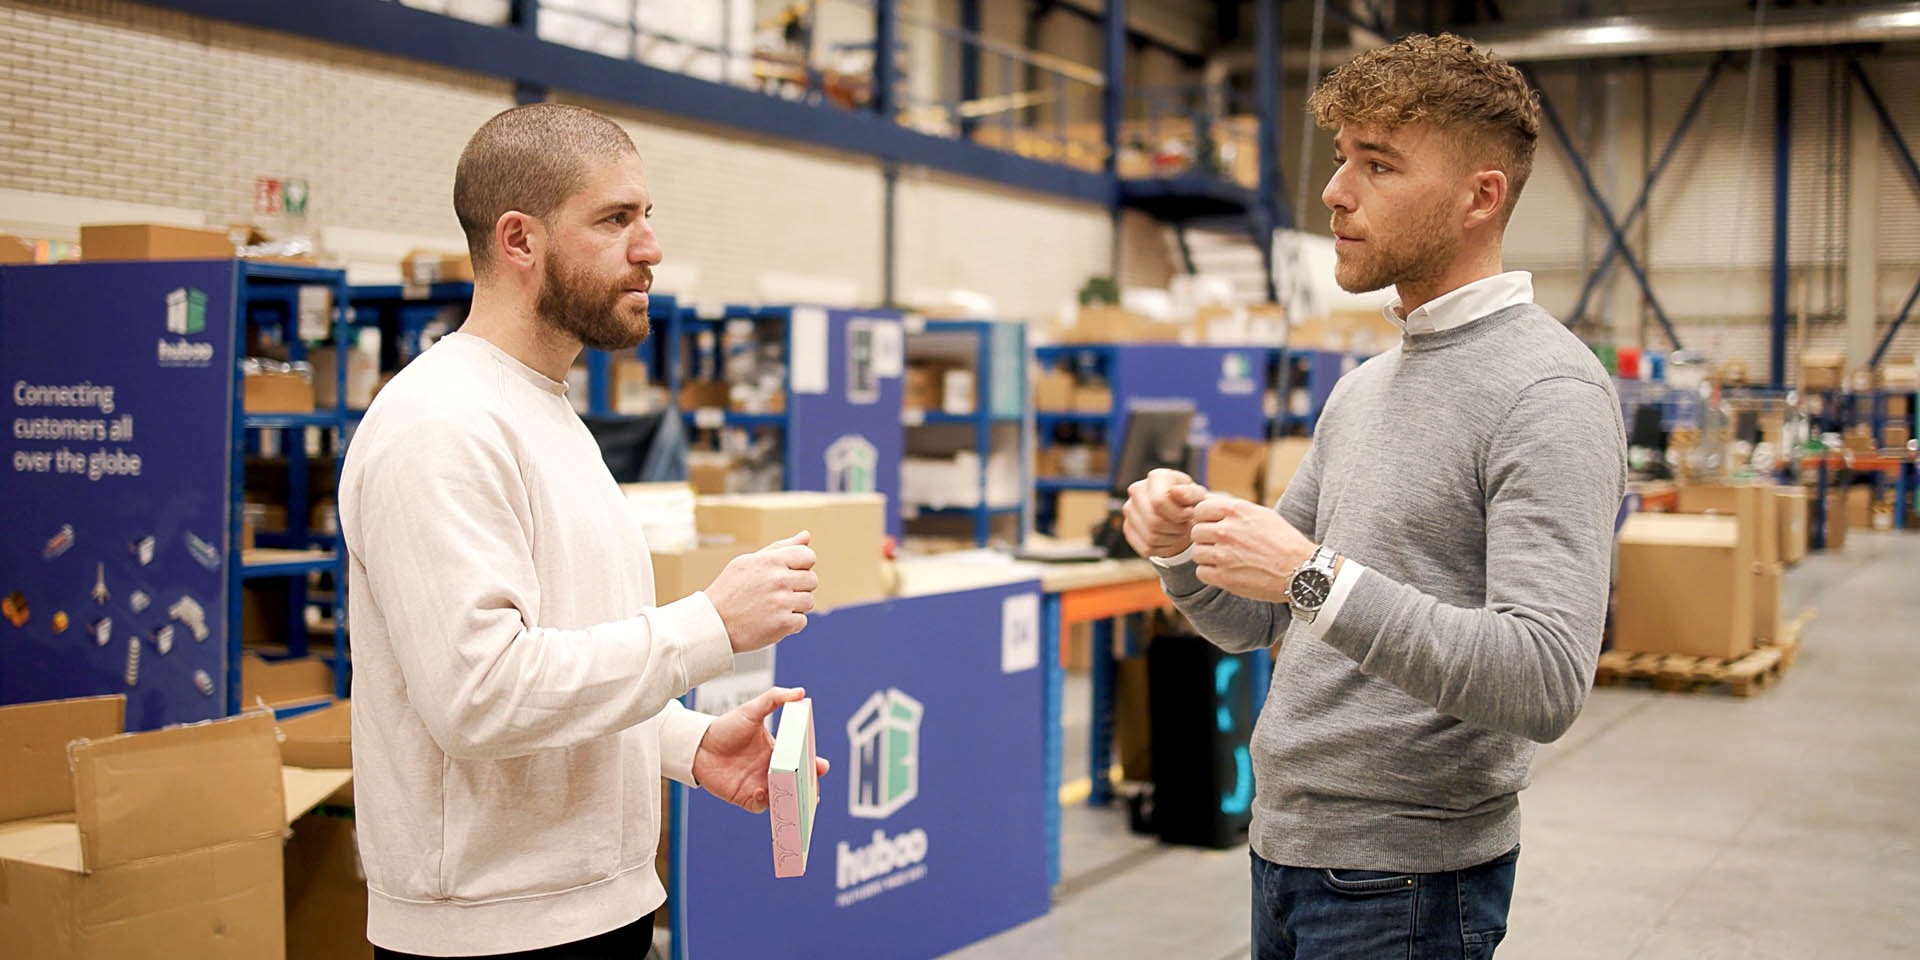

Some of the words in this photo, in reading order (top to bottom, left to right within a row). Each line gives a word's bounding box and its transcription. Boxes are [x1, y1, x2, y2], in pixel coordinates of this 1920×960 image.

[158, 338, 213, 360] huboo
[14, 380, 115, 414] Connecting
[14, 417, 107, 439] customers
[109, 414, 133, 441] all
[14, 451, 53, 472] over
[55, 447, 86, 473] the
[88, 447, 142, 480] globe
[836, 828, 928, 889] huboo
